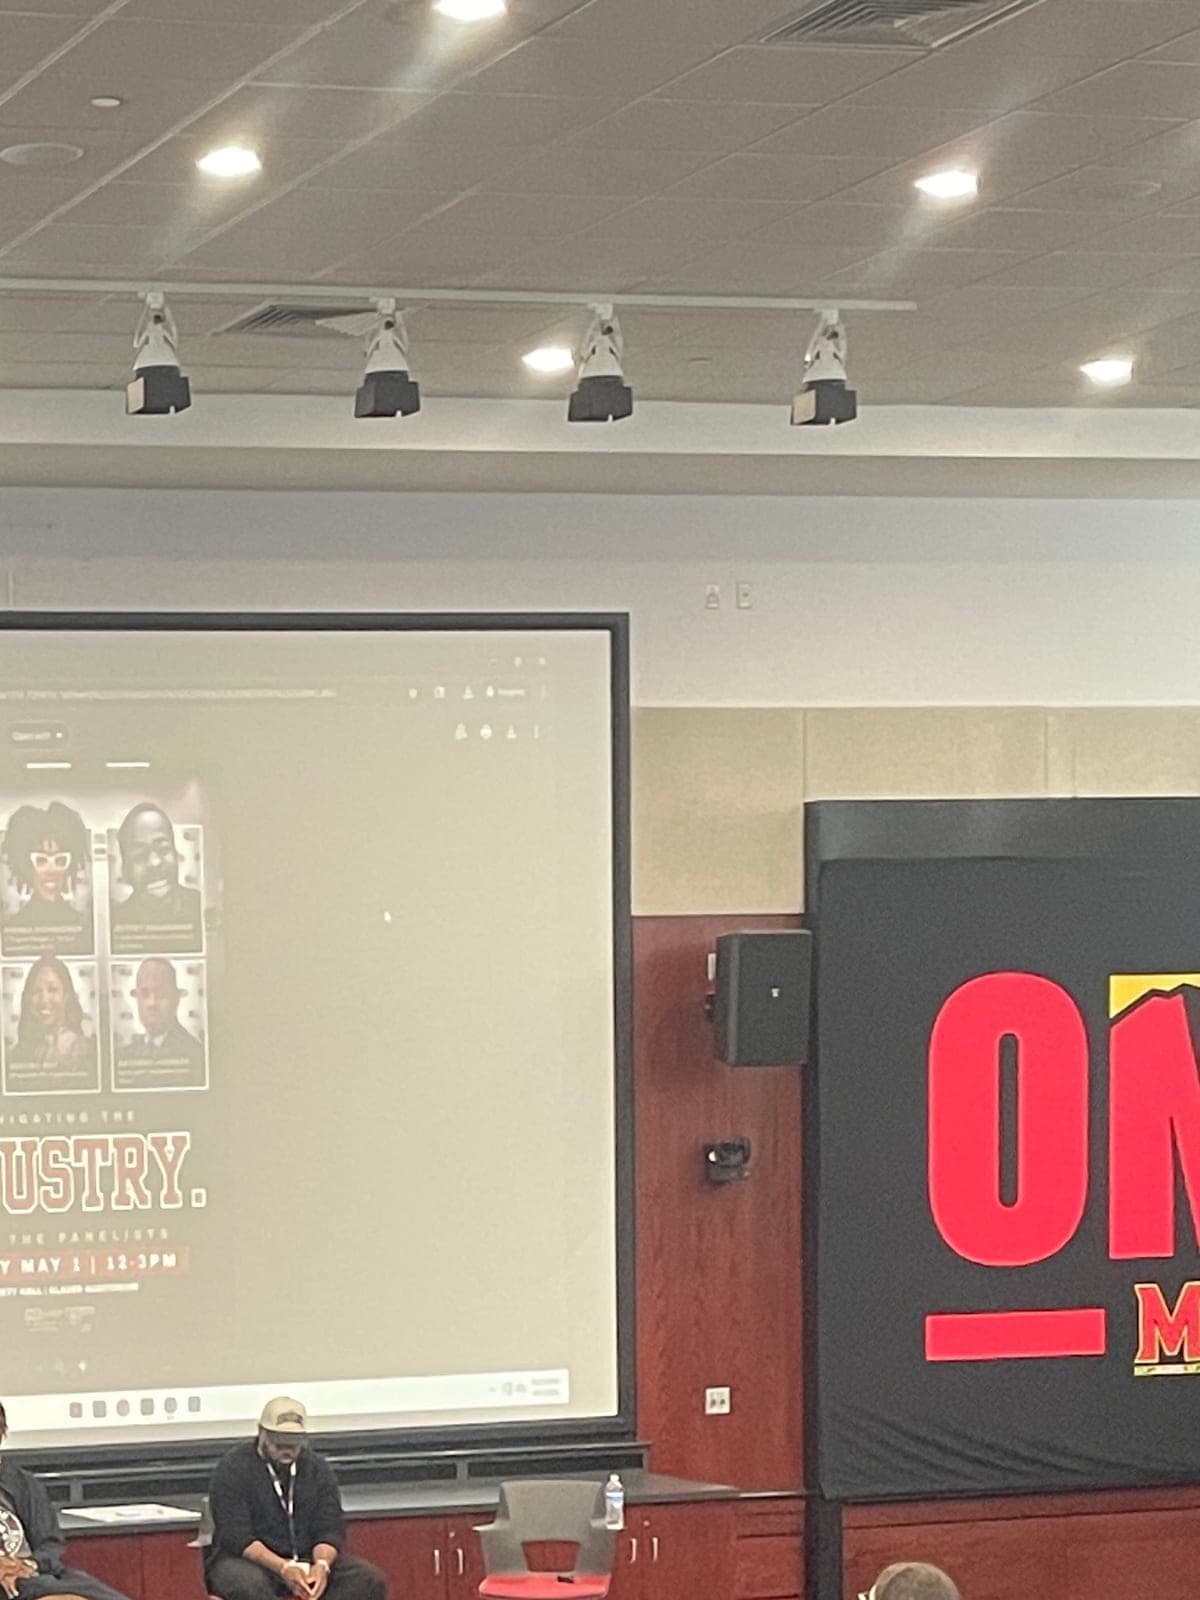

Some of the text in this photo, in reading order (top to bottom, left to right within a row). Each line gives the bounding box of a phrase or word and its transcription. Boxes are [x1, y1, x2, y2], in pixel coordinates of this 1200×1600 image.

[101, 1109, 137, 1123] THE
[9, 1231, 45, 1246] THE
[58, 1228, 170, 1245] PANELISTS
[20, 1257, 62, 1274] MAY
